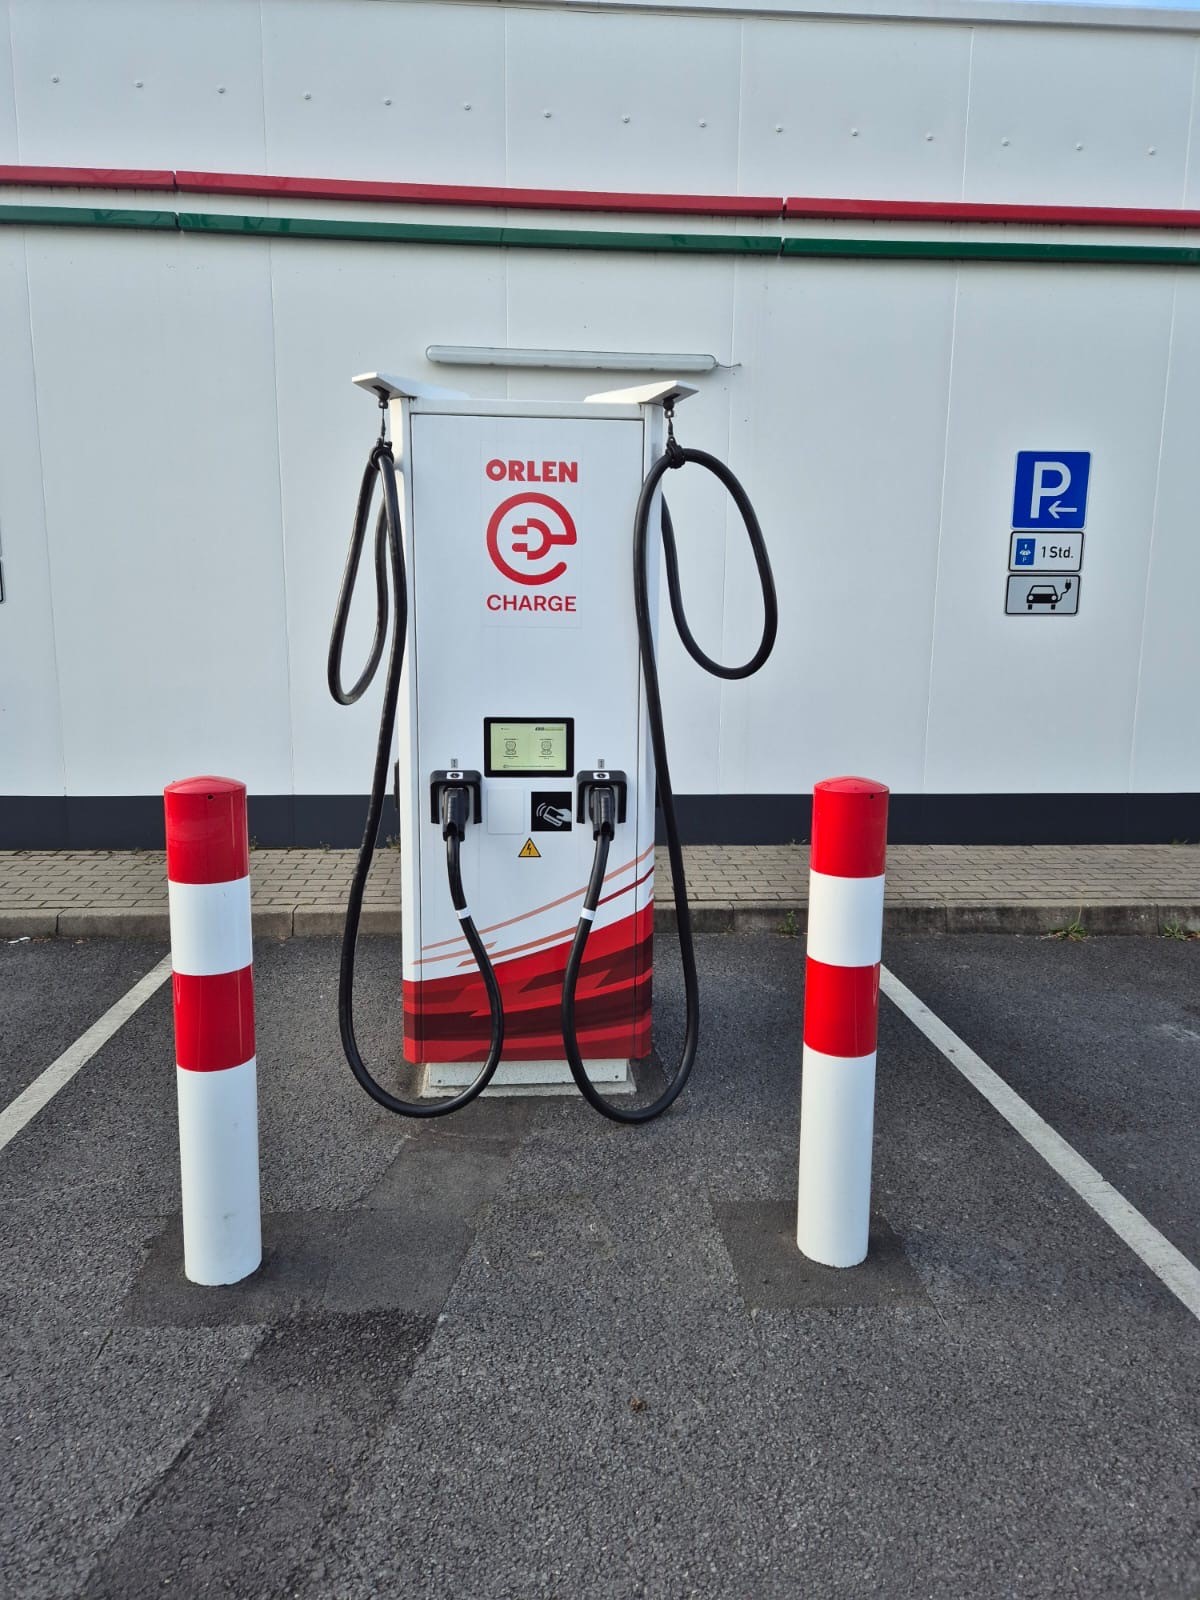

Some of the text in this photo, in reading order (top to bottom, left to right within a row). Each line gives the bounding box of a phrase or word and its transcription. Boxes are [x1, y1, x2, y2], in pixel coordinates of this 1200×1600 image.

[485, 458, 578, 483] ORLEN
[1030, 461, 1072, 519] P
[1041, 545, 1047, 559] 1
[1049, 545, 1074, 559] Std.
[486, 594, 577, 612] CHARGE
